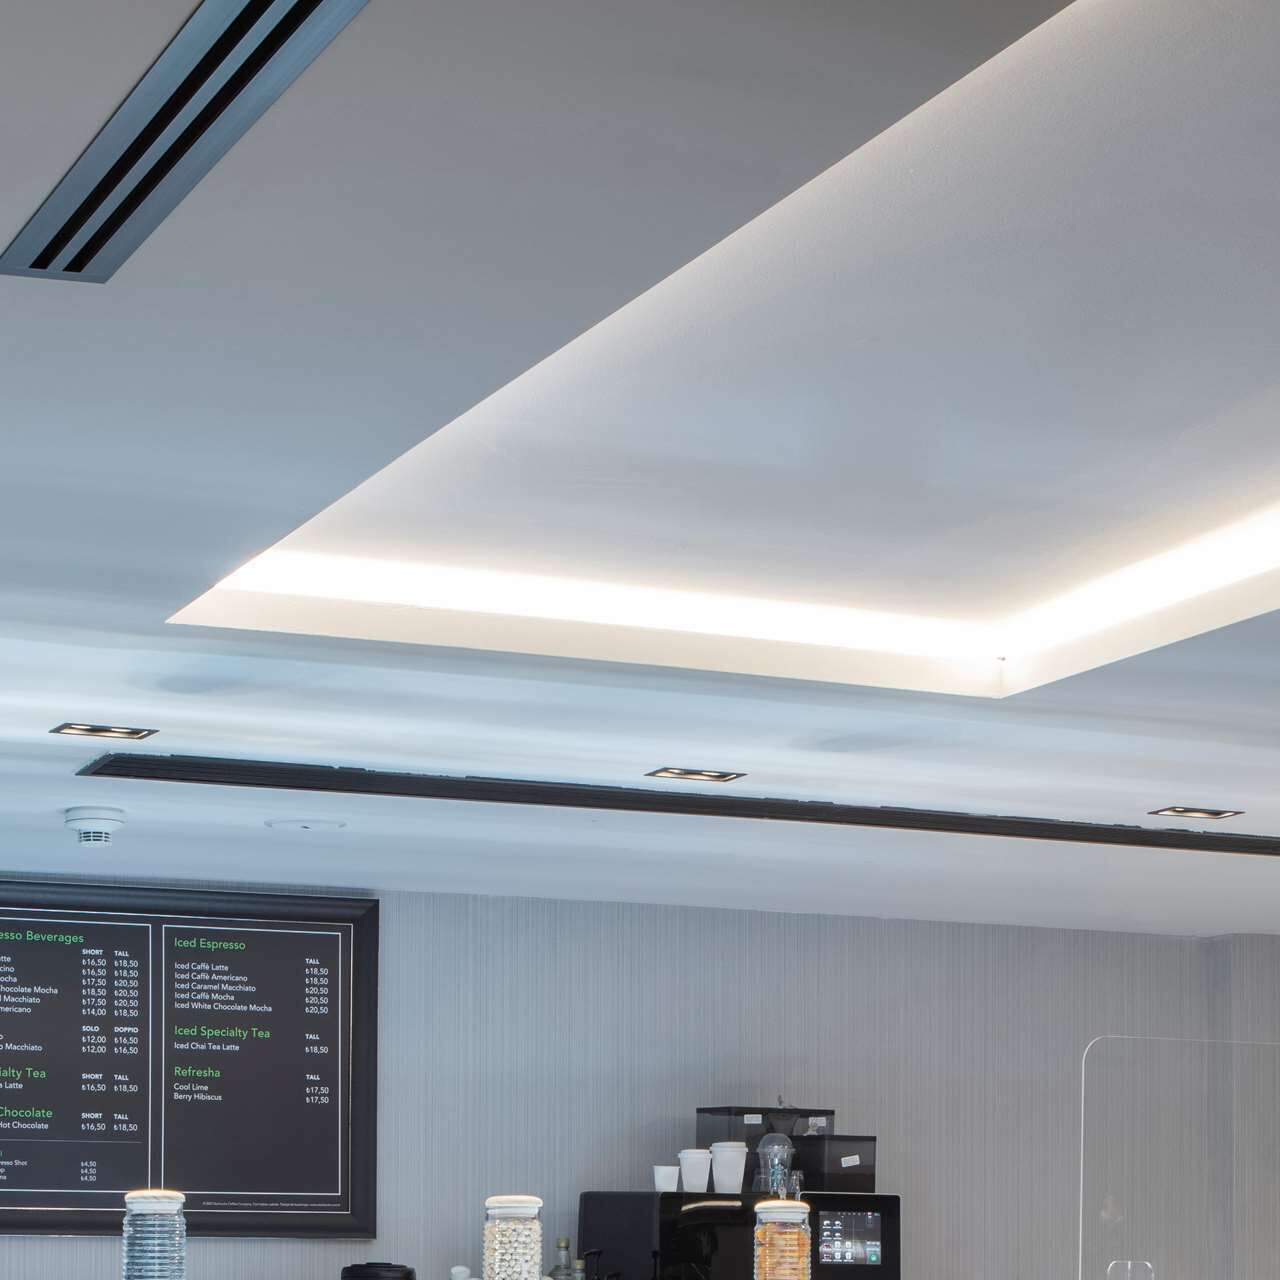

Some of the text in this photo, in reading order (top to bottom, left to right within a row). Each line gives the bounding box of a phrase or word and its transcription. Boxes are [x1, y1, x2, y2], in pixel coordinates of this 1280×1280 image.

[27, 931, 84, 944] Beverages
[175, 938, 245, 950] Iced Espresso
[175, 962, 189, 970] Iced
[175, 972, 189, 980] Iced
[222, 984, 256, 992] Macchiato
[4, 995, 40, 1003] Macchiato
[191, 992, 209, 1000] Caffè
[212, 993, 234, 1001] Mocha
[191, 1002, 211, 1010] White
[213, 1003, 248, 1011] Chocolate
[249, 1004, 272, 1012] Mocha
[175, 1026, 270, 1040] Iced Specialty Tea
[5, 1043, 42, 1051] Macchiato
[191, 1042, 206, 1050] Chai
[222, 1043, 239, 1051] Latte
[26, 1068, 46, 1078] Tea
[174, 1067, 220, 1077] Refresha
[174, 1093, 222, 1101] Berry Hibiscus
